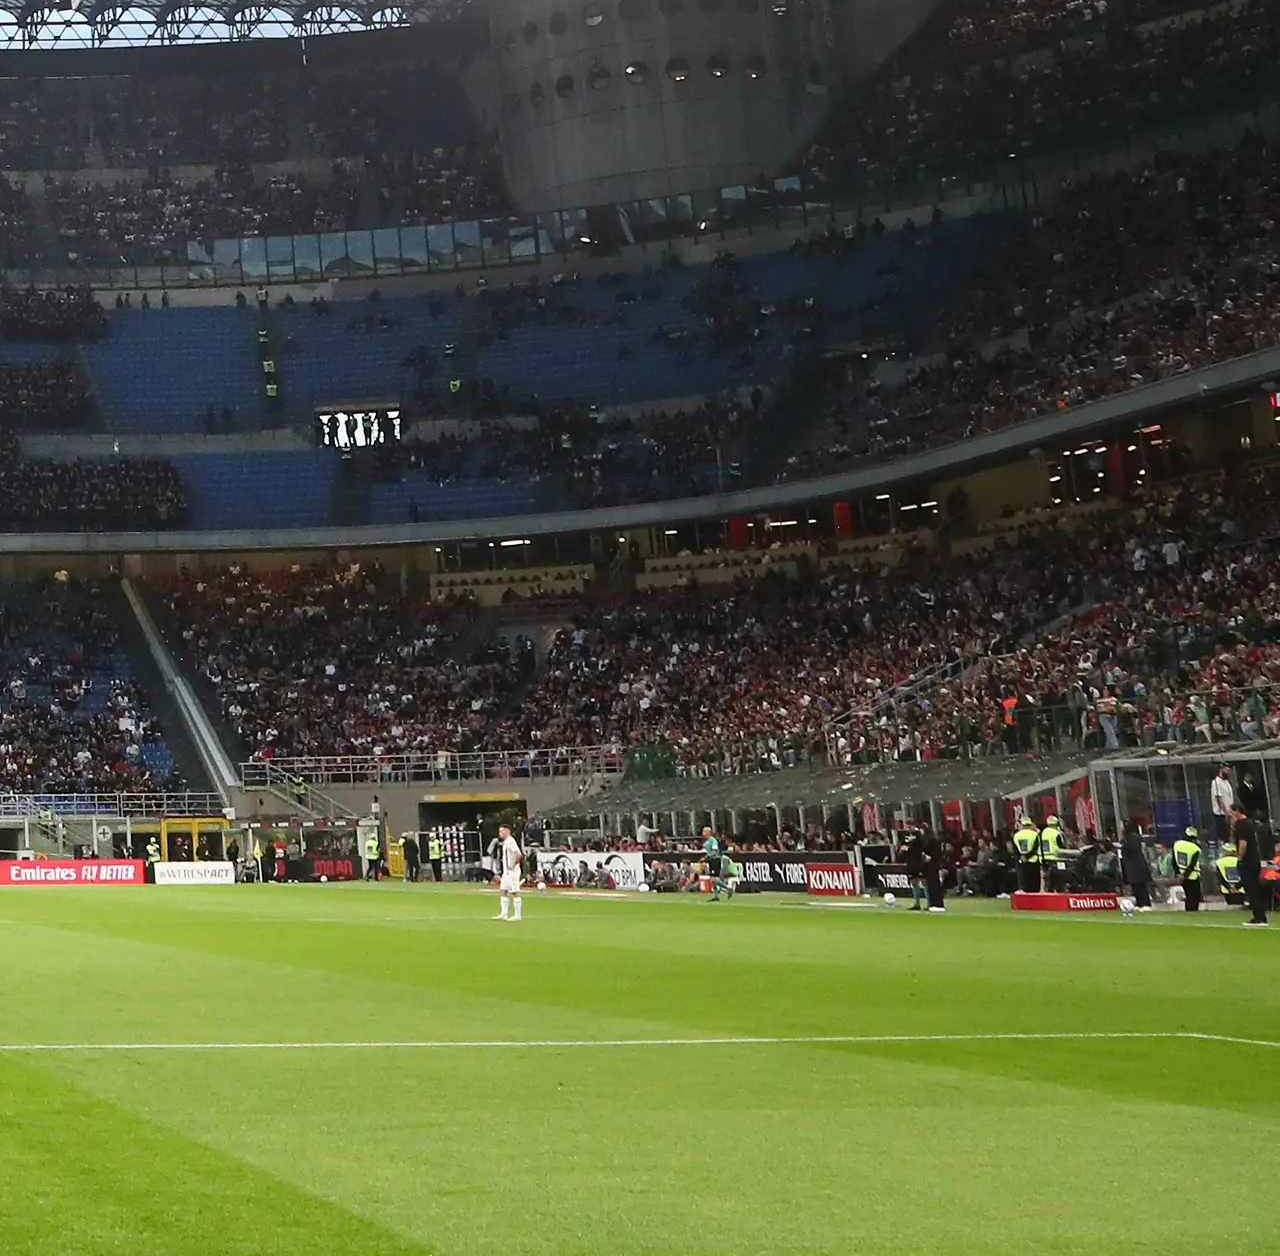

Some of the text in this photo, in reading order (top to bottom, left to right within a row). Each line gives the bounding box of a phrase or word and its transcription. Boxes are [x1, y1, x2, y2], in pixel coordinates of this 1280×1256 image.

[10, 865, 135, 881] Emirates FLY BETTER
[809, 870, 854, 891] KONAMI
[1068, 896, 1116, 909] Emirates
